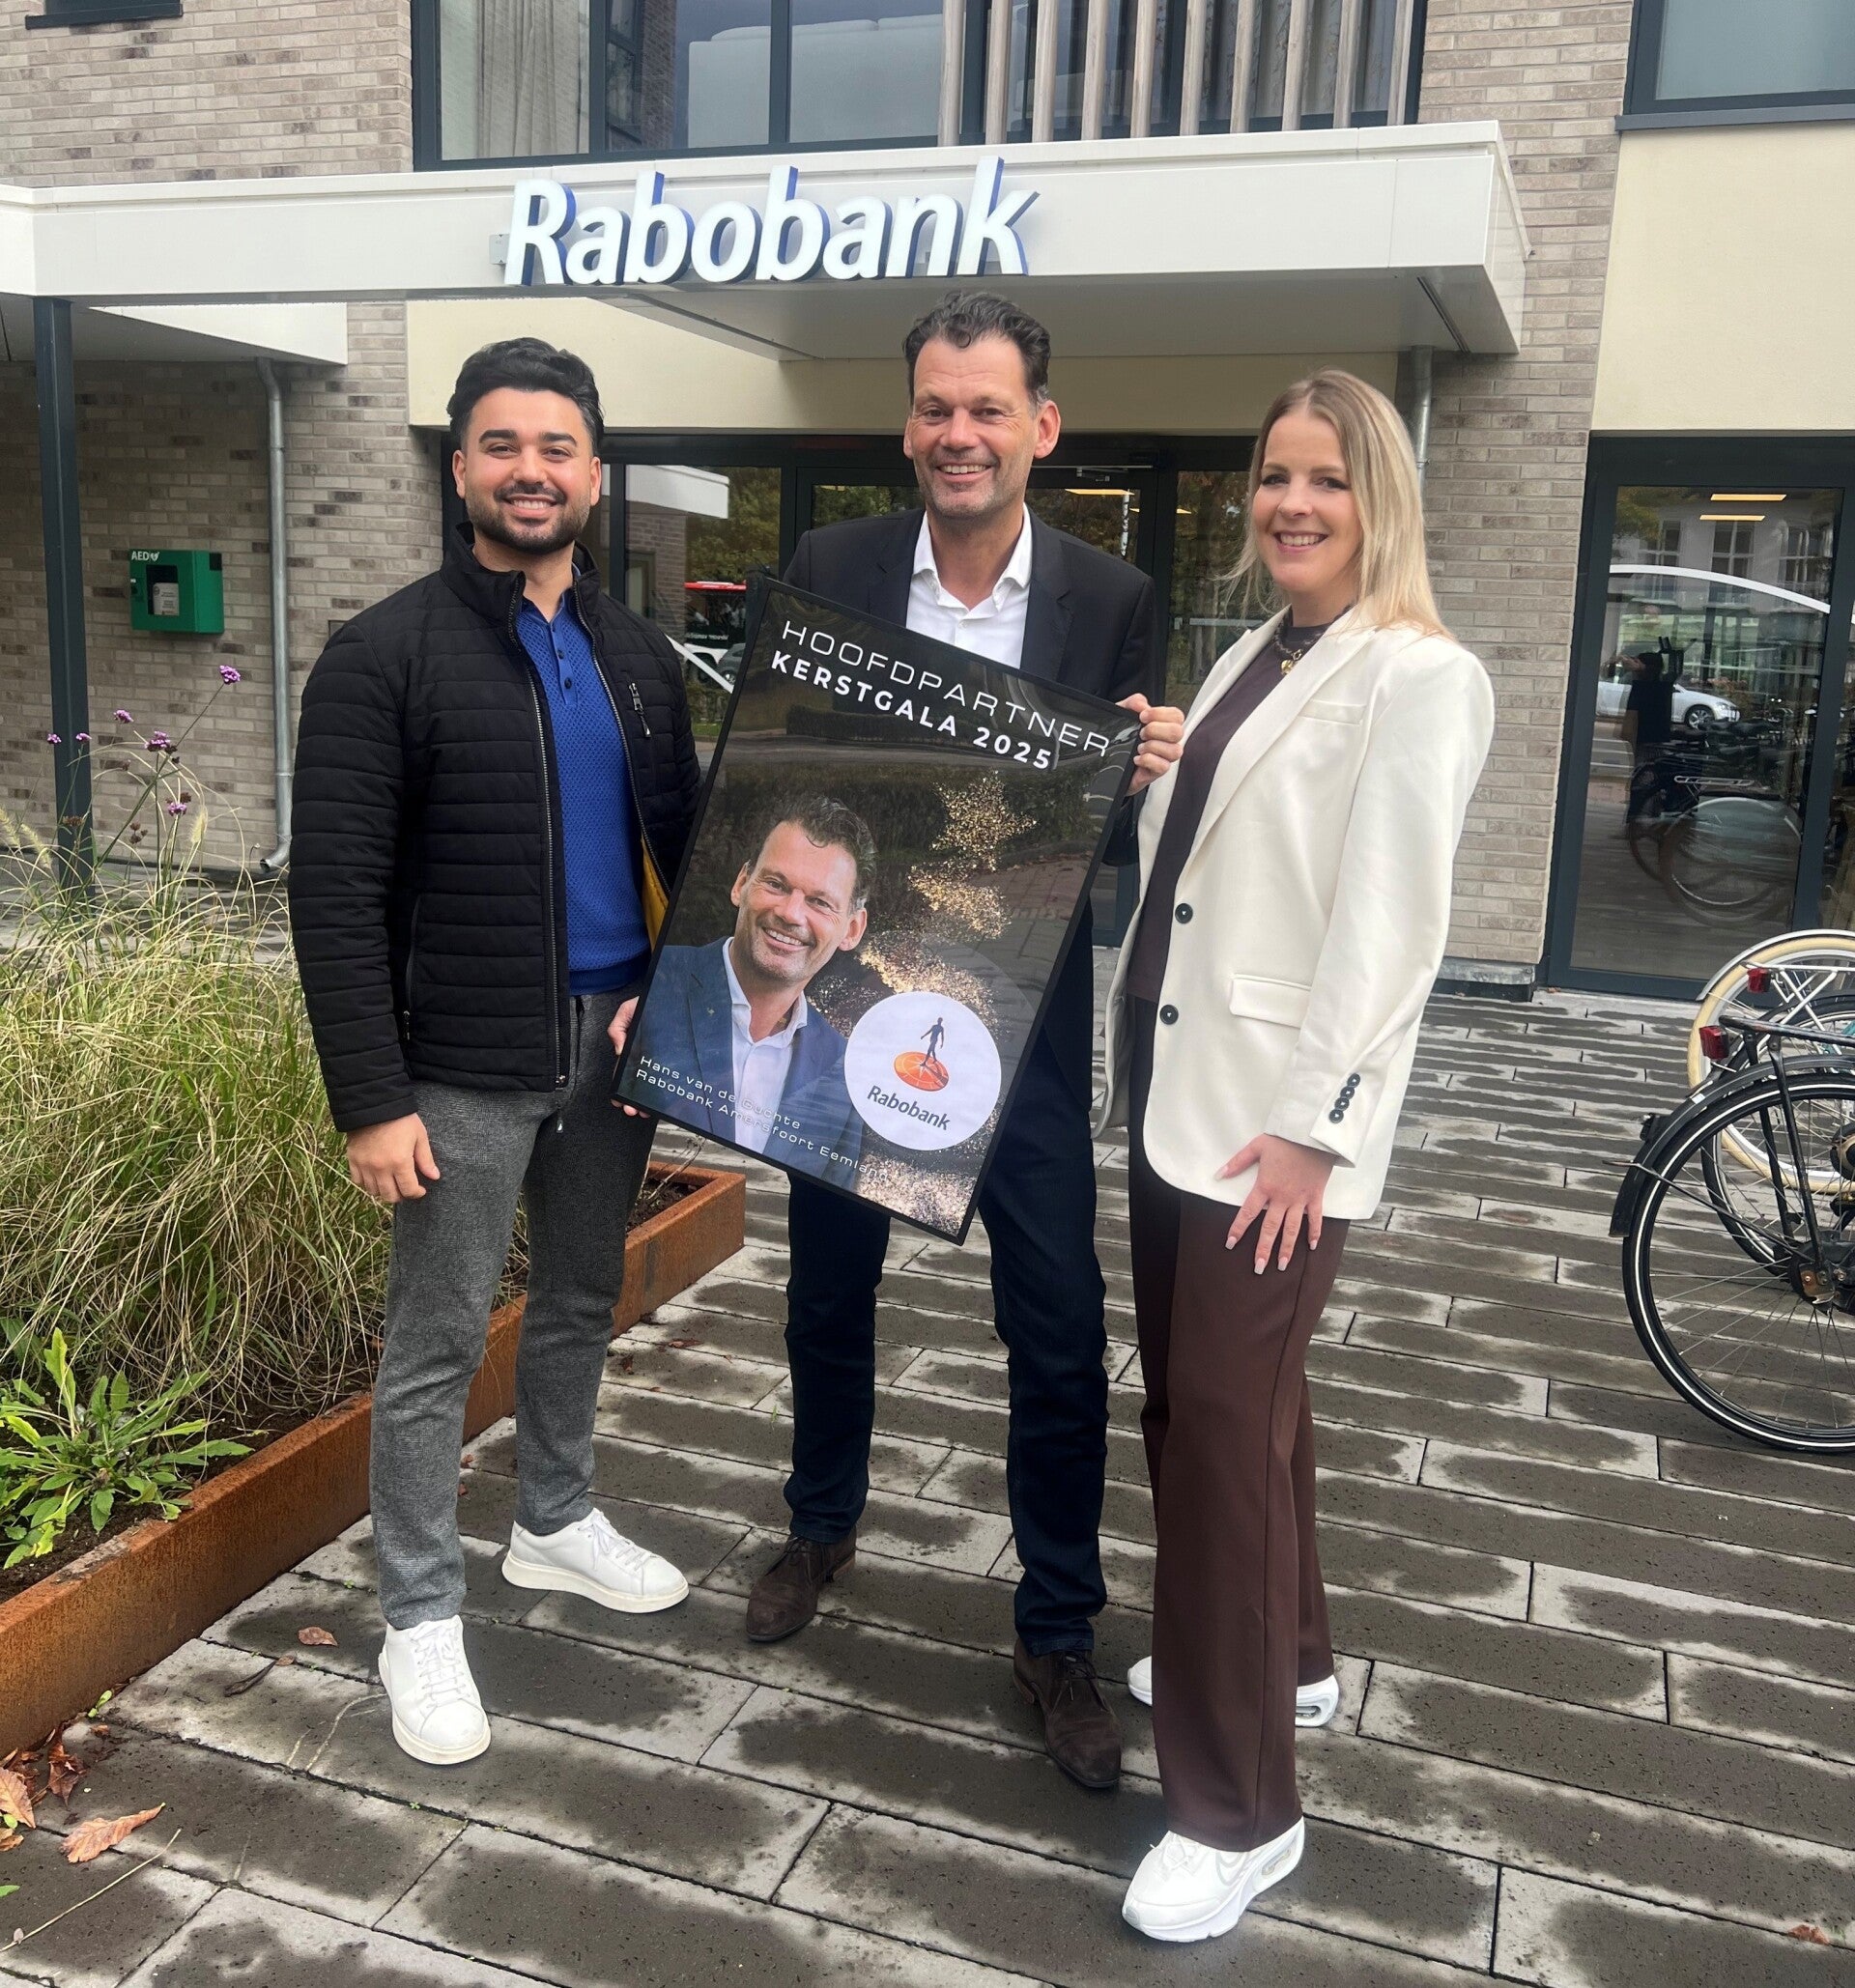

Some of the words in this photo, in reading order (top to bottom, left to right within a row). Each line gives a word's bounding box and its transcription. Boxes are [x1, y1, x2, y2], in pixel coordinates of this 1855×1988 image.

[503, 156, 1041, 287] Rabobank
[131, 551, 150, 561] AED
[771, 650, 956, 737] KERSTGALA
[972, 725, 1052, 770] 2025
[781, 620, 1111, 757] HOOFDPARTNER
[636, 1068, 714, 1108] Rabobank
[718, 1104, 815, 1151] Amersfoort
[819, 1146, 888, 1181] Eemland
[640, 1055, 679, 1079] Hans
[686, 1075, 713, 1093] van
[718, 1090, 736, 1103] de
[742, 1097, 801, 1129] Guchte
[867, 1085, 951, 1131] Rabobank
